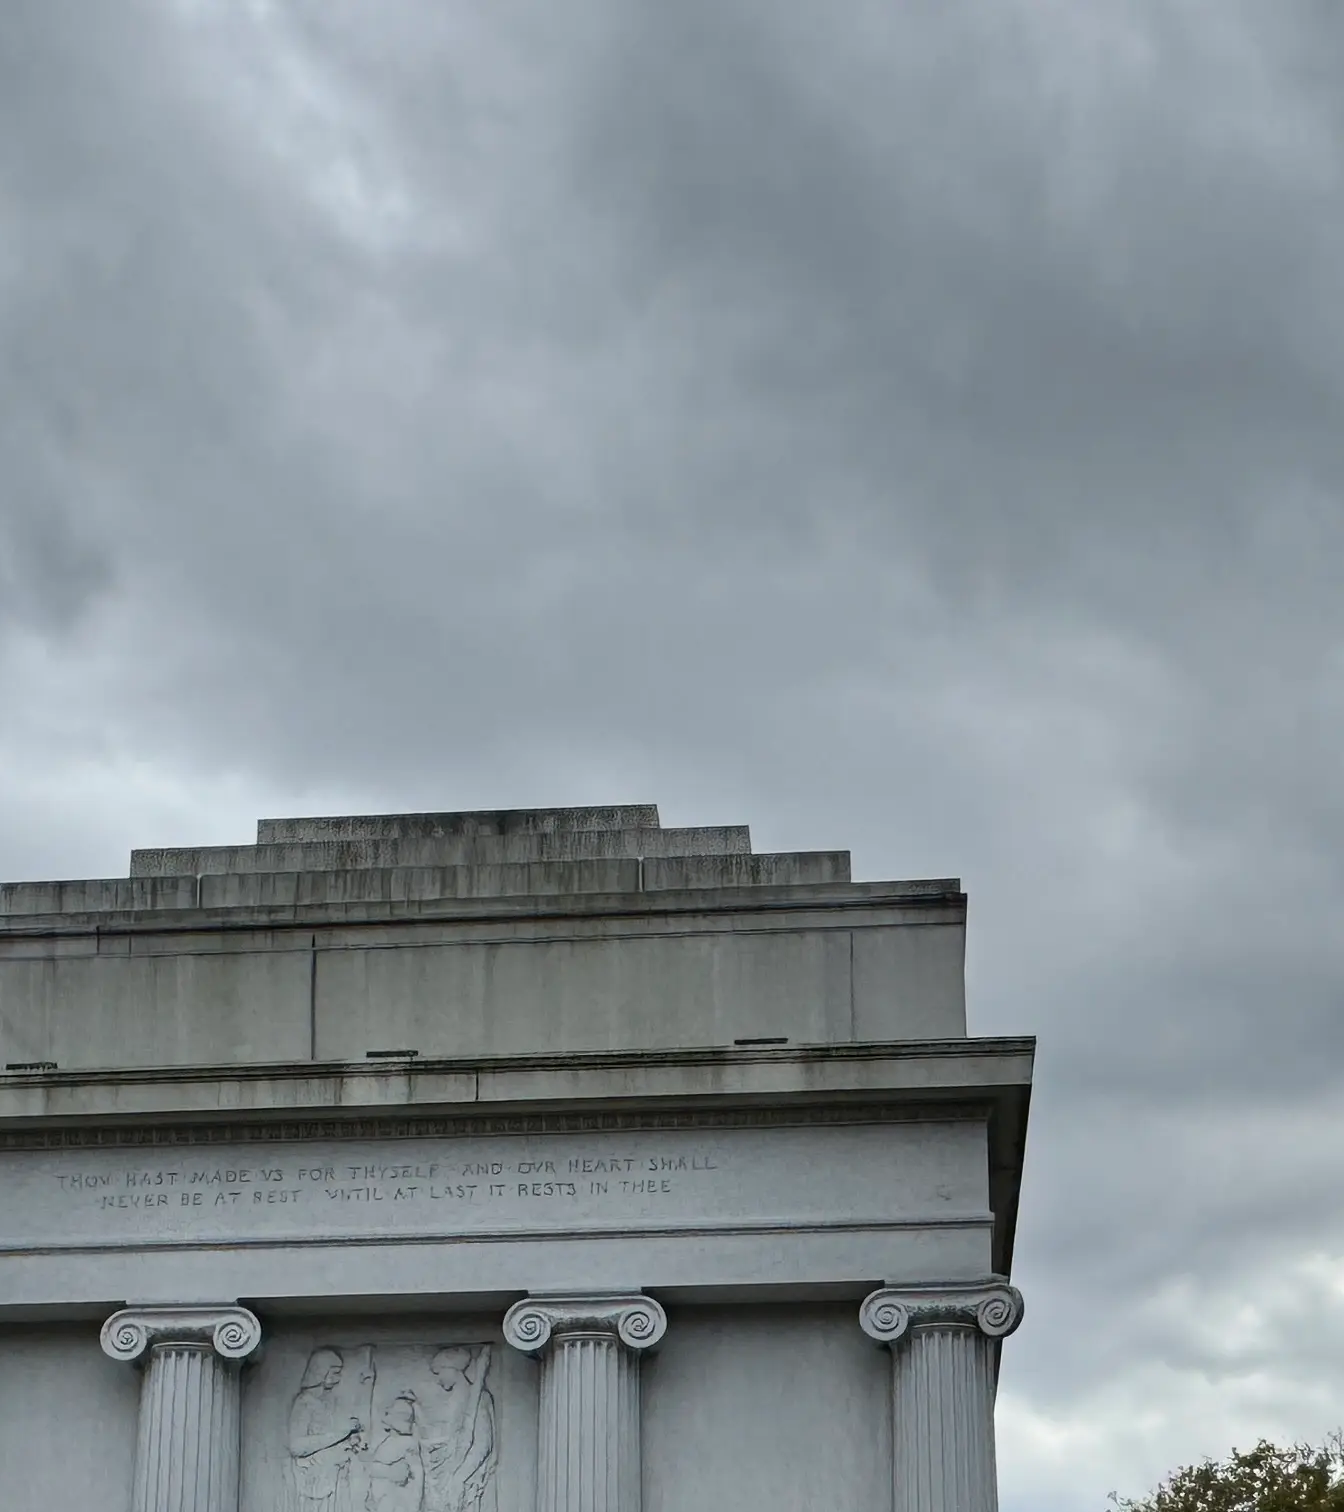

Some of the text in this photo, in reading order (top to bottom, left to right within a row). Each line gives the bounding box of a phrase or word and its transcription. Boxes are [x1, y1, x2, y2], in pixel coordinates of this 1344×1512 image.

[126, 1171, 179, 1187] HAST
[189, 1168, 252, 1186] MADE
[297, 1167, 336, 1182] FOR
[346, 1163, 440, 1180] THYSELF
[462, 1161, 504, 1177] AND
[568, 1157, 636, 1173] HEART
[647, 1154, 718, 1172] SHALL
[99, 1193, 169, 1210] NEVER
[180, 1192, 204, 1207] BE
[214, 1191, 243, 1207] AT
[252, 1188, 303, 1205] REST
[393, 1185, 419, 1201] AT
[430, 1184, 478, 1200] LAST
[489, 1183, 507, 1198] IT
[517, 1181, 577, 1197] RESTS
[590, 1180, 609, 1196] IN
[618, 1178, 672, 1195] THEE
